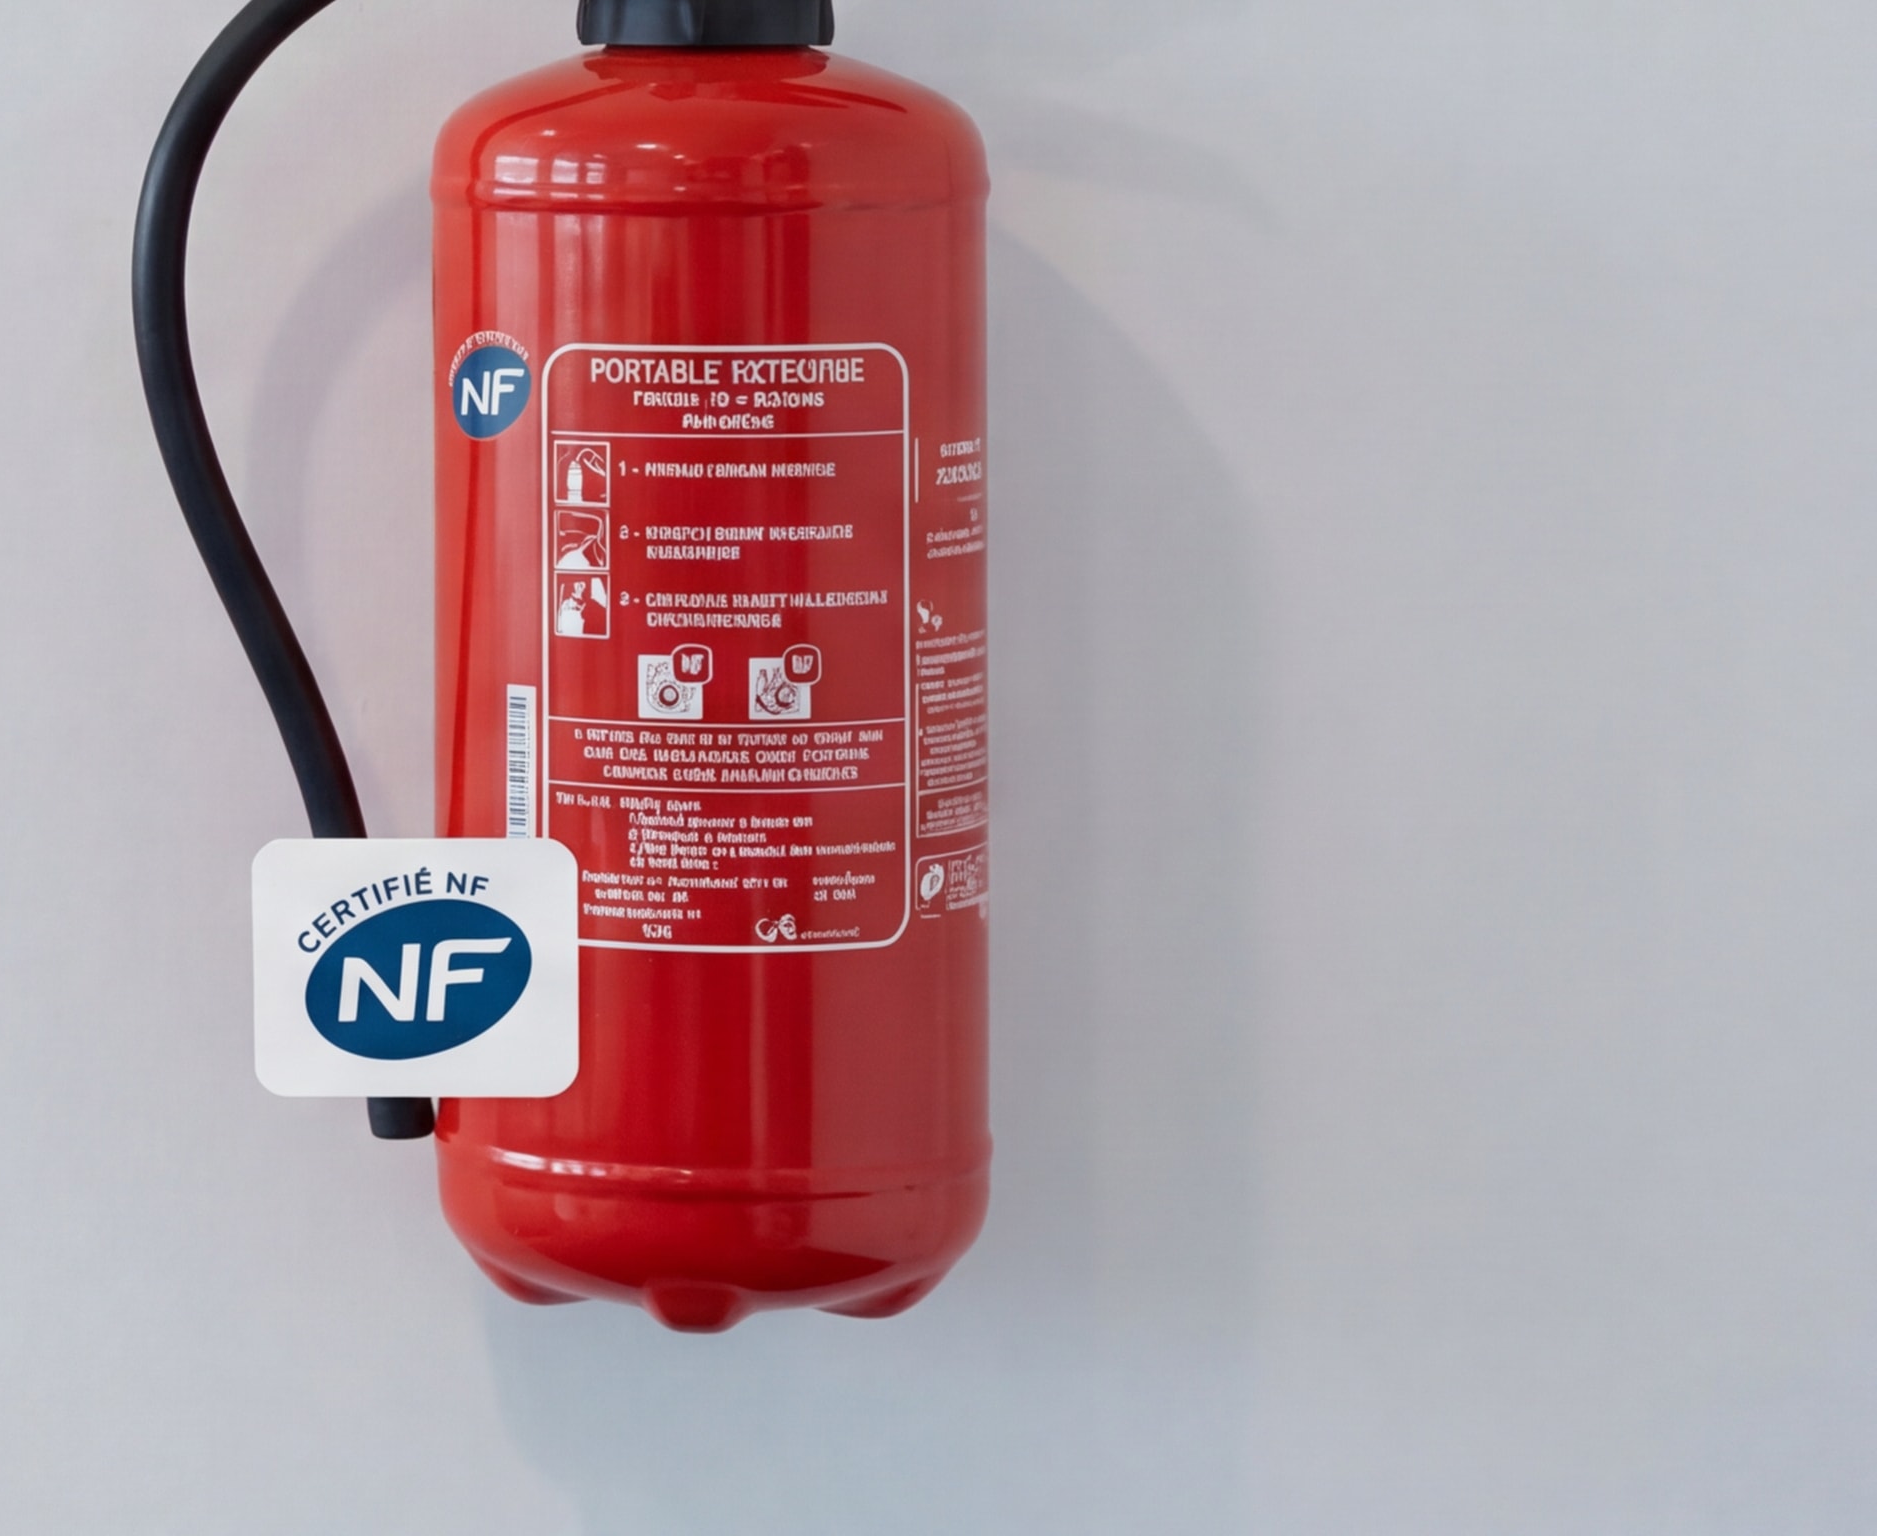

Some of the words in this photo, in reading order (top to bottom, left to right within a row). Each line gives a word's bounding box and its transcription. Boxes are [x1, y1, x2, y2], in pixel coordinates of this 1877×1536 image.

[460, 368, 525, 416] NF
[590, 357, 723, 385] PORTABLE
[297, 866, 433, 954] CERTIFIÉ
[445, 871, 489, 897] NF
[338, 936, 512, 1023] NF
